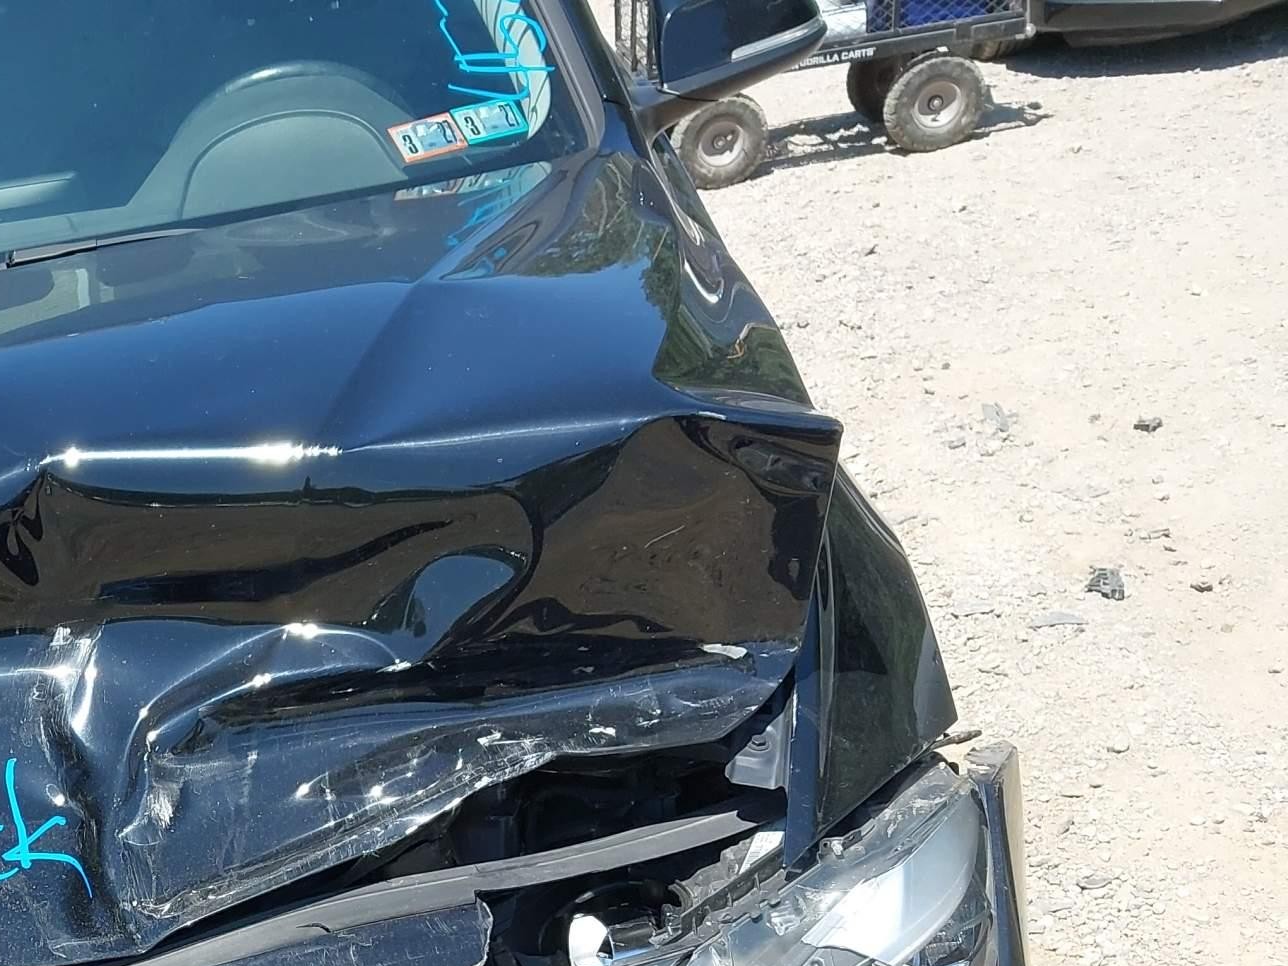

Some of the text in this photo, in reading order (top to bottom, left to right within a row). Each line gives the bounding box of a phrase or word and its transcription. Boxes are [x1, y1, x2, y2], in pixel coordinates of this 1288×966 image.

[841, 47, 875, 60] CARTS
[463, 115, 482, 136] 3
[402, 134, 419, 154] 3
